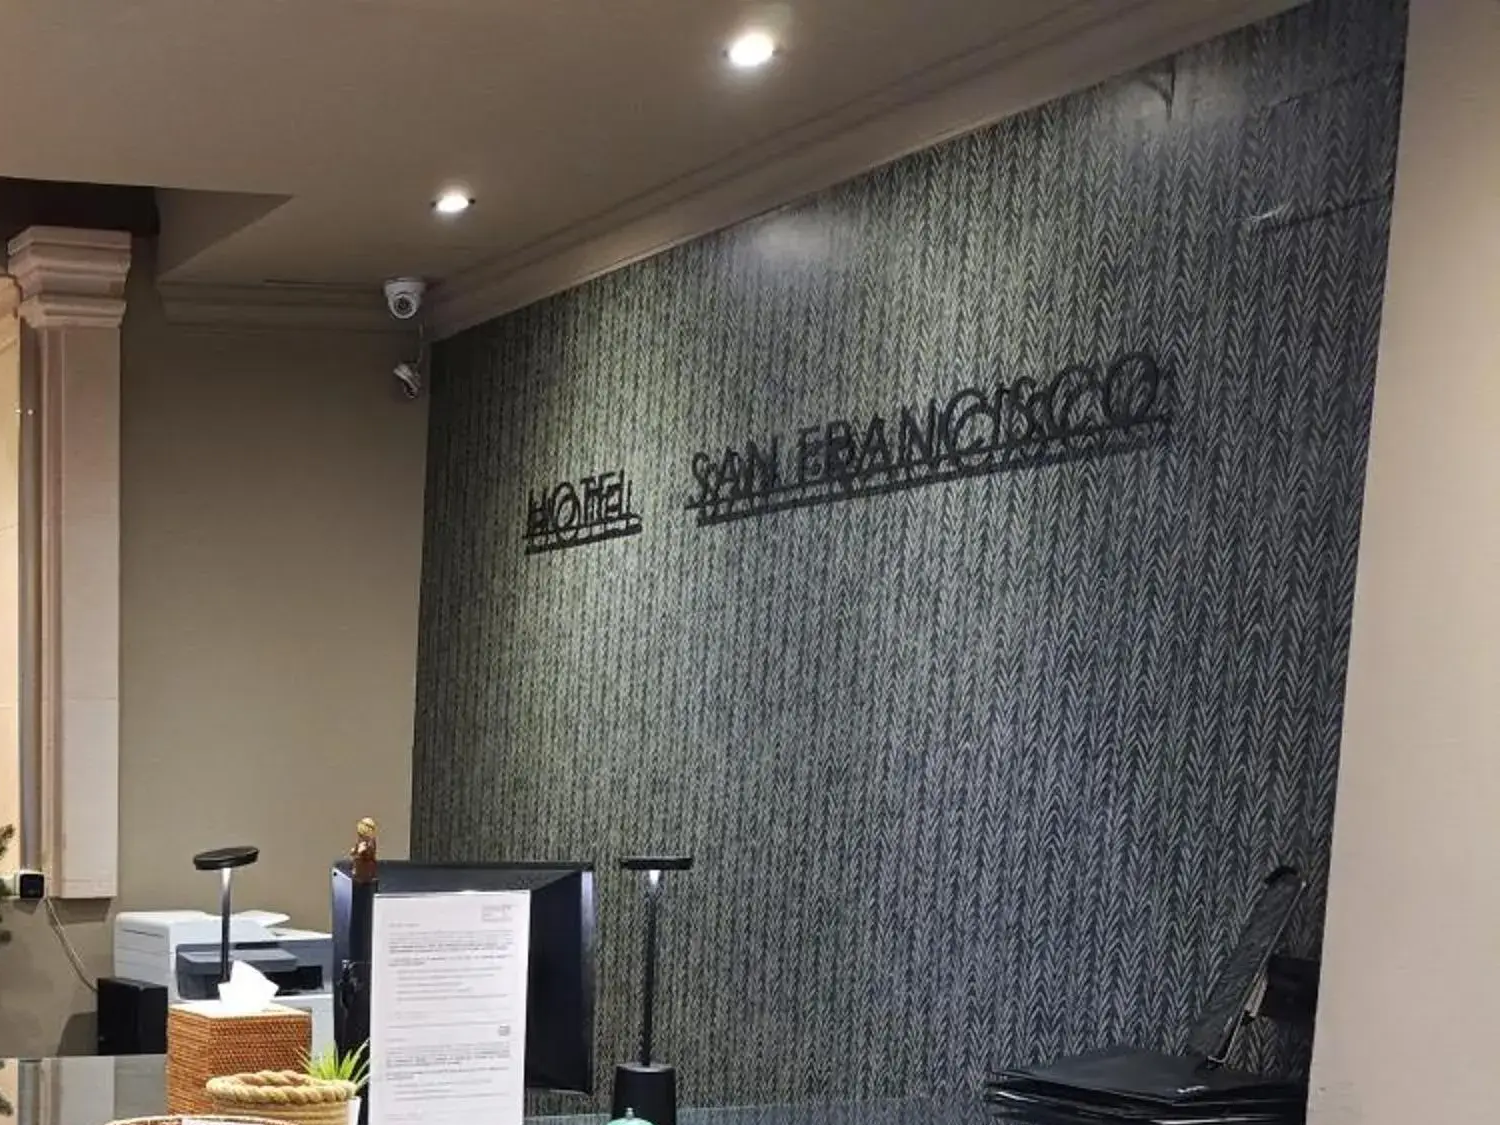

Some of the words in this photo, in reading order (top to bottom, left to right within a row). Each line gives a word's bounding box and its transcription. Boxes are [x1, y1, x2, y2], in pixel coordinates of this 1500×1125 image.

[524, 467, 638, 550] HOTEL
[688, 433, 781, 510] SAN
[796, 351, 1164, 488] FRANCISCO
